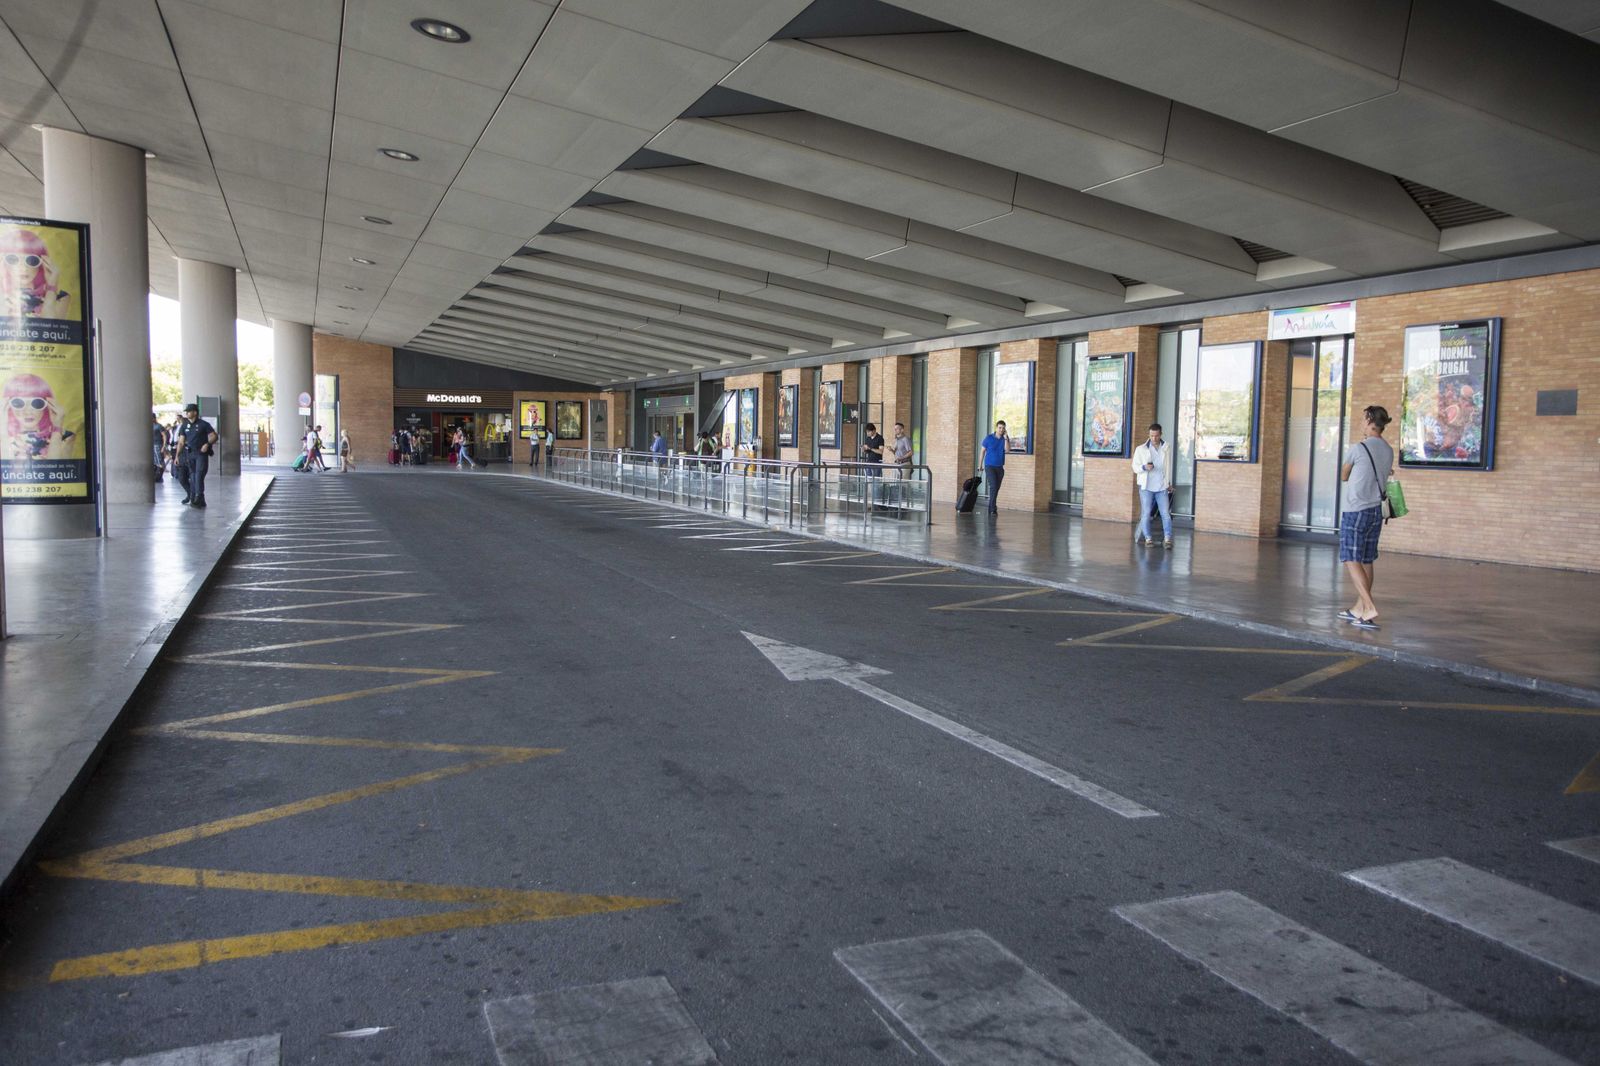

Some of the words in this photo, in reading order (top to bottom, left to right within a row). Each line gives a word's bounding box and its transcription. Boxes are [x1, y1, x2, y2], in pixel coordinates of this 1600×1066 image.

[43, 330, 71, 341] aquí.
[39, 345, 56, 353] 207
[1440, 345, 1477, 361] NORMAL,
[1437, 360, 1470, 375] BRUGAL
[427, 394, 482, 403] McDonald's
[48, 469, 77, 481] aquí.
